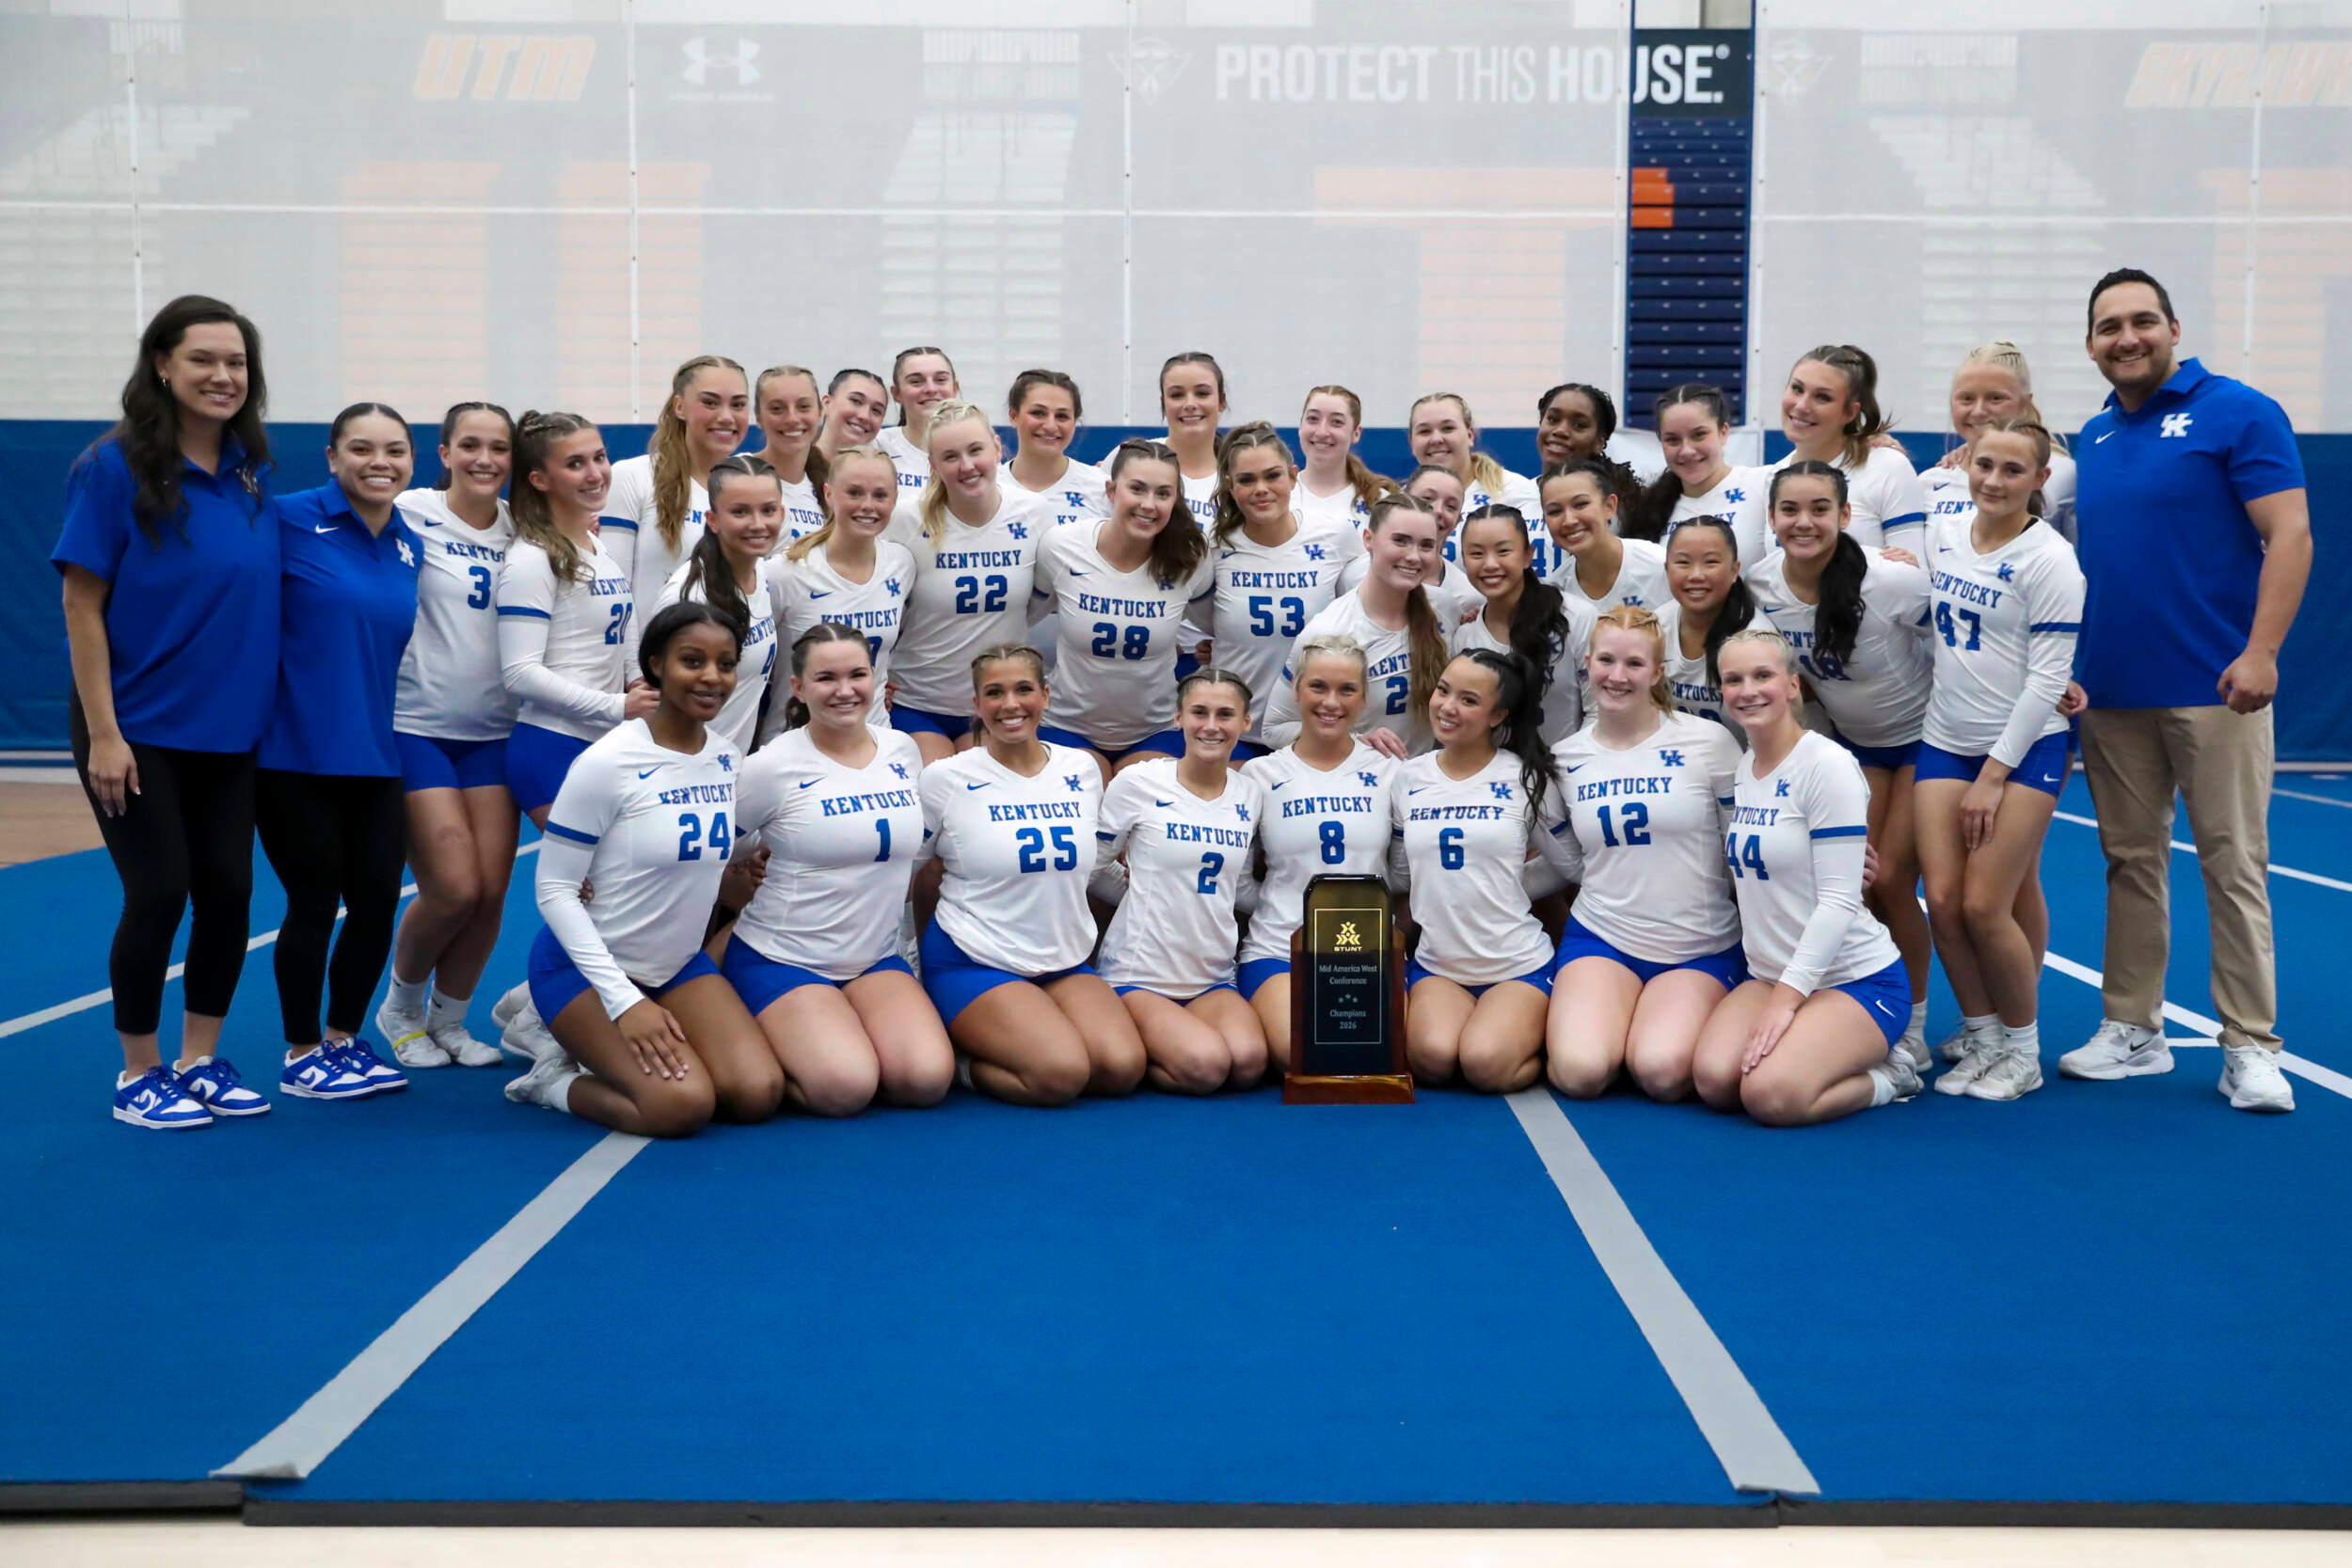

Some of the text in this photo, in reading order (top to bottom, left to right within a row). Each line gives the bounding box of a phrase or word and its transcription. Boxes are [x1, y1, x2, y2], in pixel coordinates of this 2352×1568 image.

[411, 34, 596, 101] UTM
[1215, 44, 1438, 103] PROTECT
[1449, 45, 1535, 103] THIS
[936, 548, 1022, 569] KENTUCKY
[468, 565, 491, 610] 3
[955, 574, 1009, 614] 22
[1232, 571, 1319, 589] KENTUCKY
[820, 607, 898, 629] KENTUCKY
[1079, 594, 1167, 618] KENTUCKY
[1248, 595, 1305, 638] 53
[1935, 600, 1981, 652] 47
[1092, 622, 1151, 661] 28
[1385, 675, 1408, 716] 2
[1660, 749, 1686, 768] UK
[1358, 771, 1378, 787] UK
[1490, 782, 1514, 800] UK
[1577, 776, 1673, 802] KENTUCKY
[658, 783, 733, 805] KENTUCKY
[820, 789, 916, 817] KENTUCKY
[1282, 797, 1372, 818] KENTUCKY
[988, 801, 1082, 823] KENTUCKY
[1410, 805, 1505, 821] KENTUCKY
[1597, 802, 1651, 847] 12
[677, 812, 731, 863] 24
[874, 817, 892, 863] 1
[1166, 821, 1249, 848] KENTUCKY
[1318, 820, 1345, 865] 8
[1015, 825, 1077, 874] 25
[1438, 827, 1465, 871] 6
[1725, 832, 1770, 881] 44
[1197, 851, 1225, 895] 2
[1319, 965, 1377, 974] Mid America West
[1329, 976, 1367, 985] Conference
[1329, 1009, 1366, 1019] Champions
